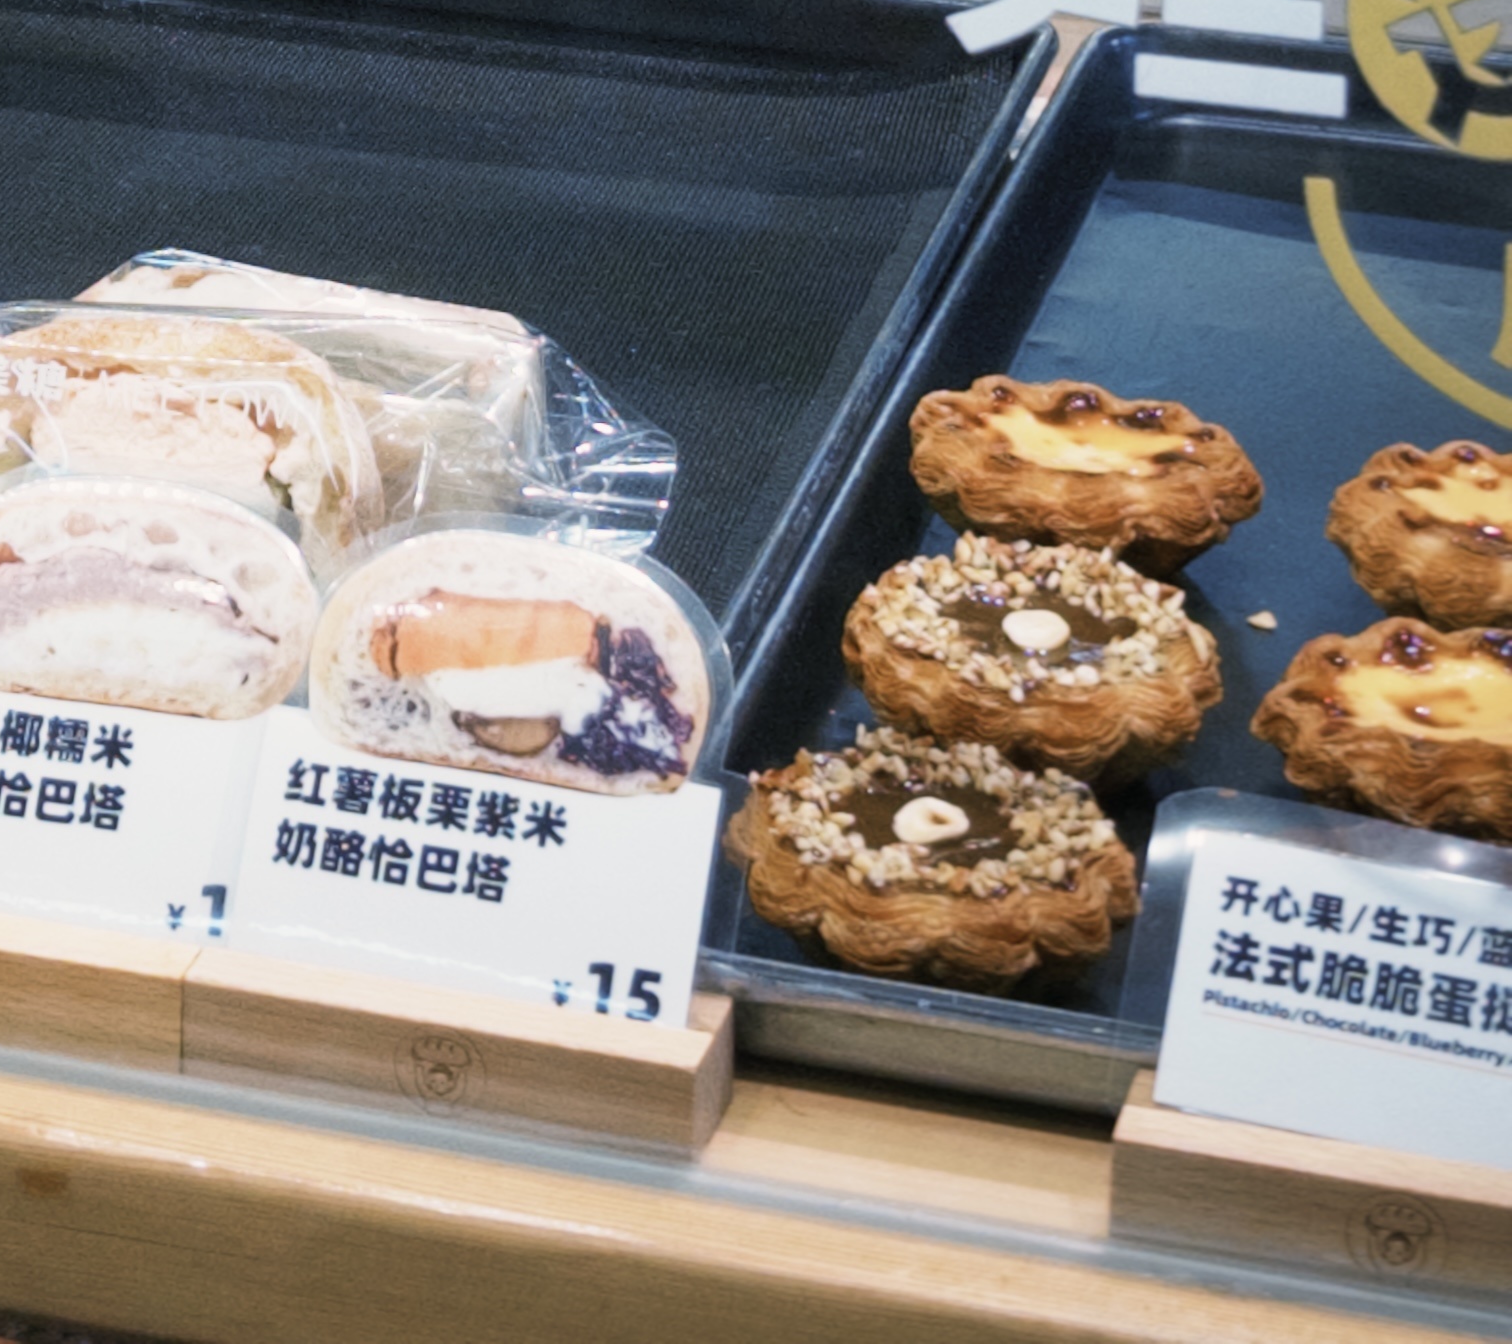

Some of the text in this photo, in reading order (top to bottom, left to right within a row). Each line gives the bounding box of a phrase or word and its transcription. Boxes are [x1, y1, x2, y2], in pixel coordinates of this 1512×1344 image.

[283, 758, 568, 849] 红薯板栗紫米
[272, 818, 512, 904] 奶酪恰巴塔
